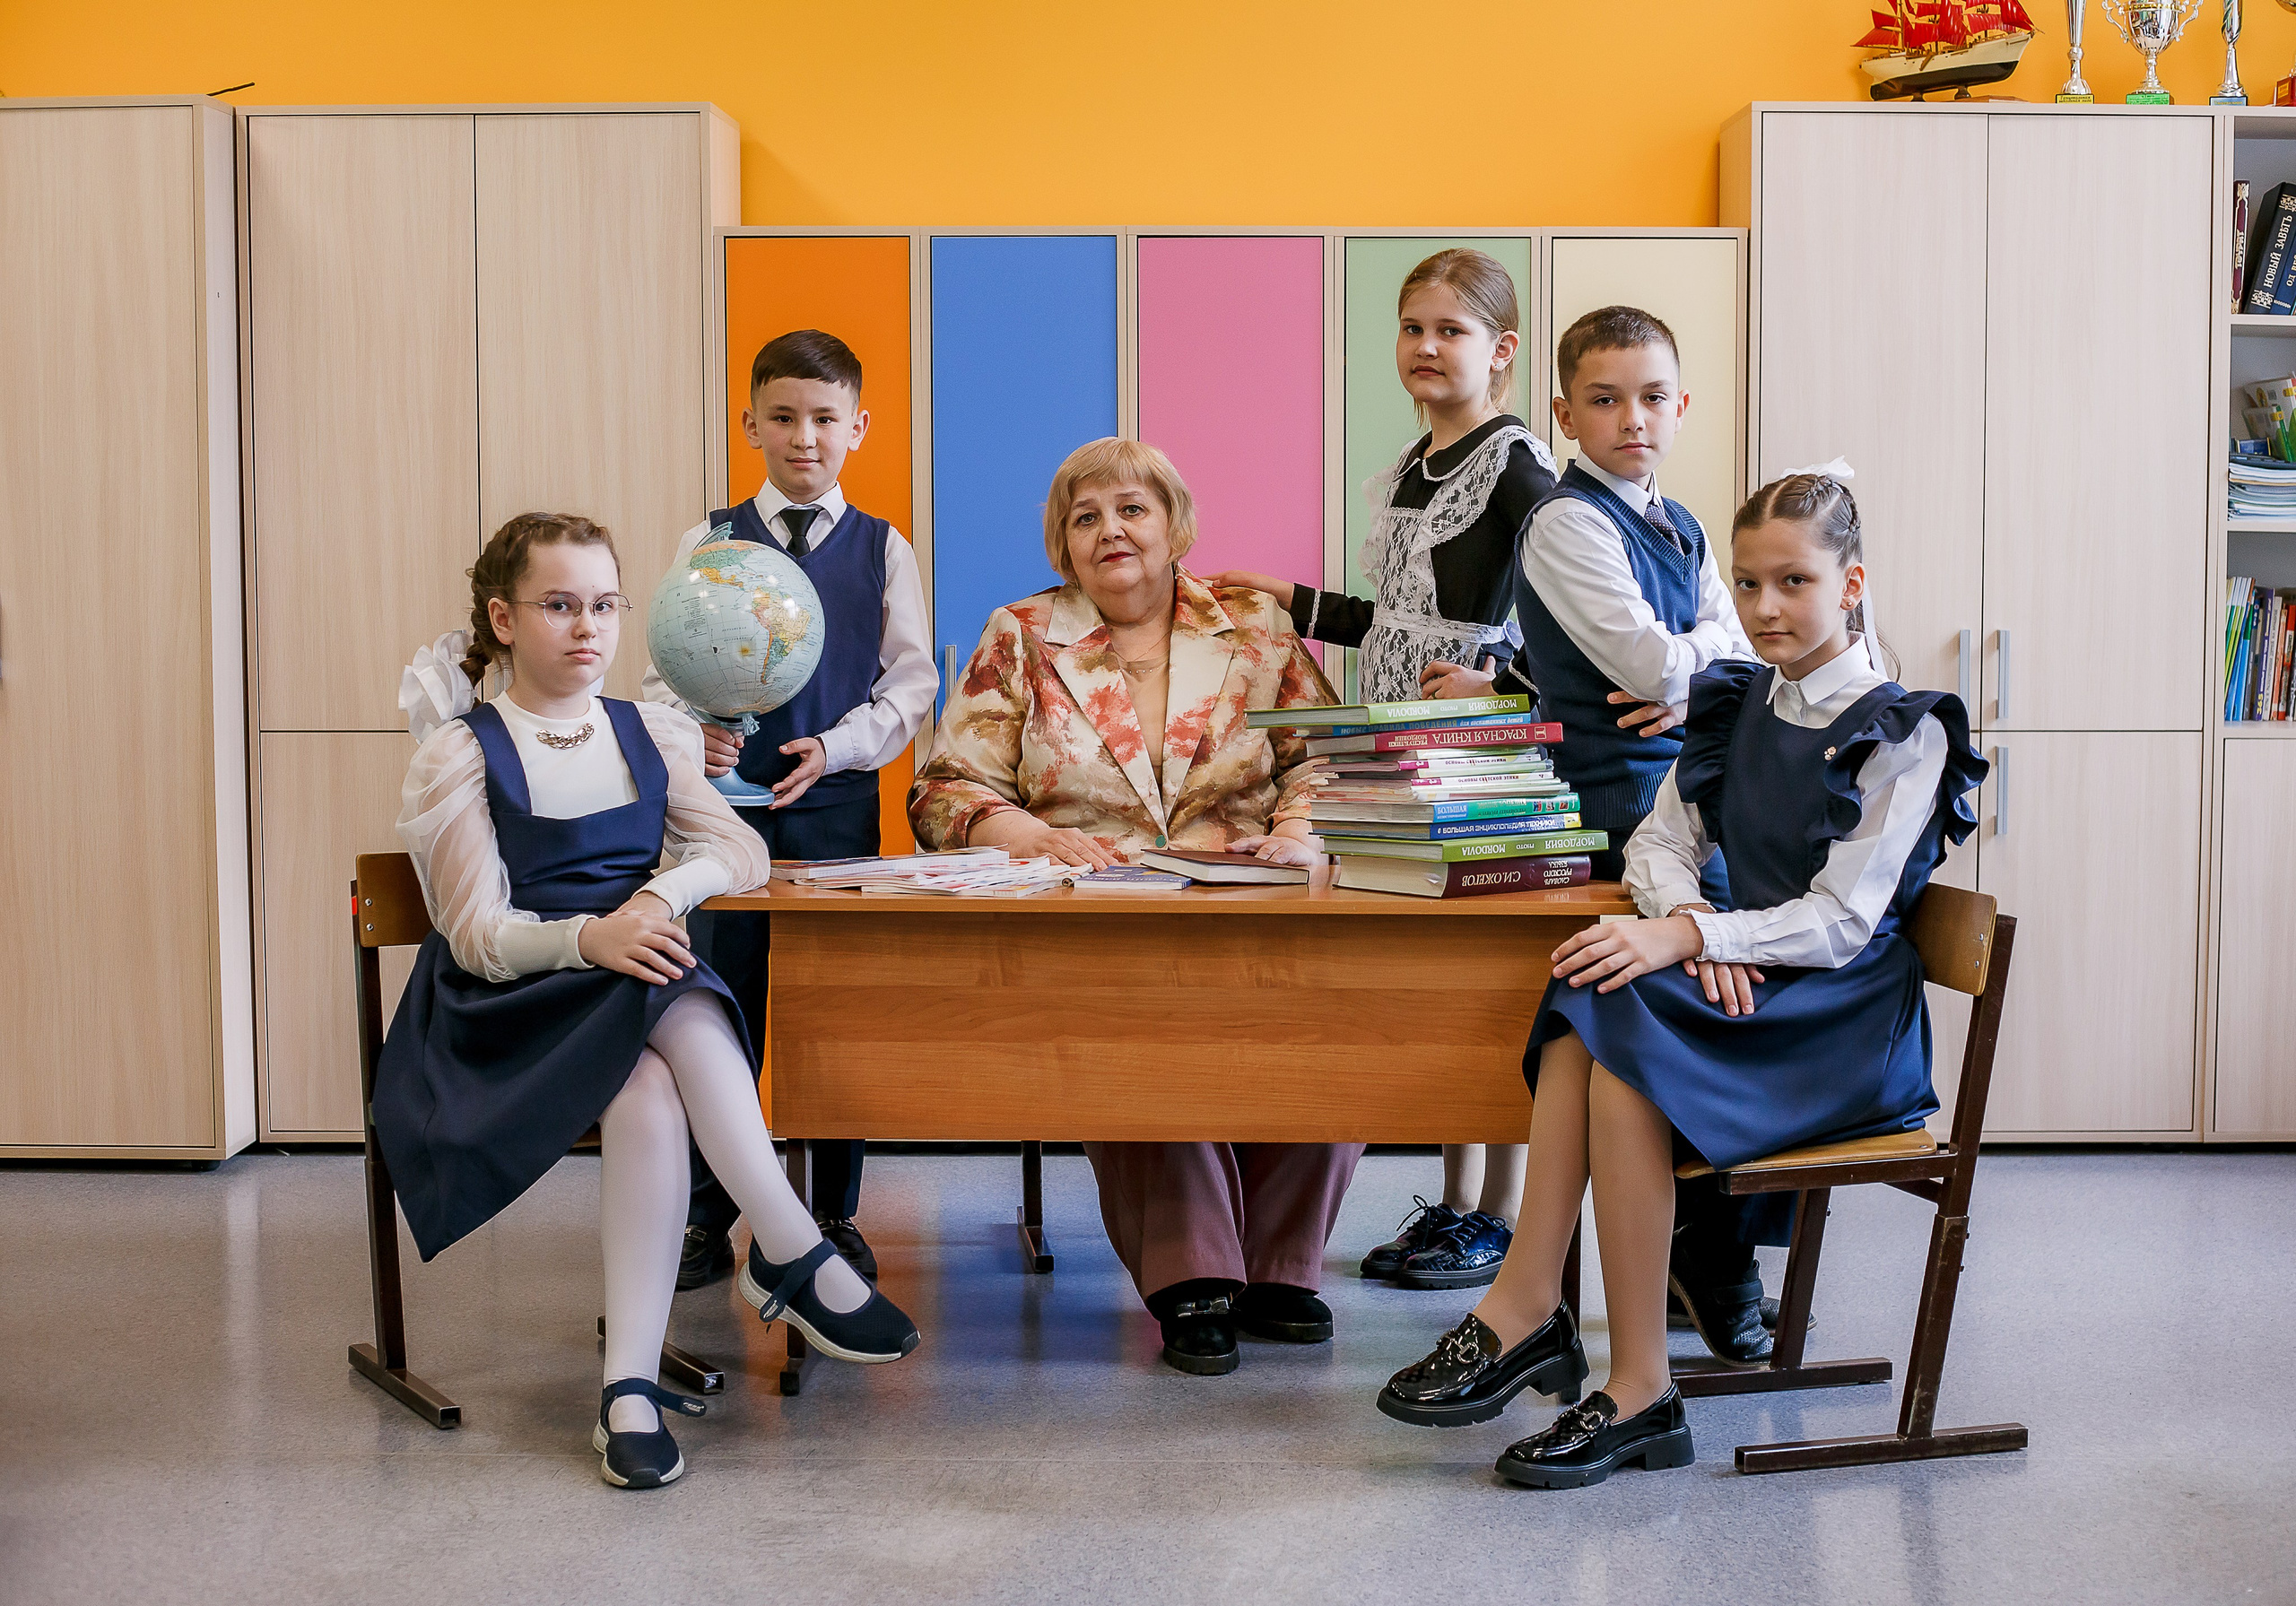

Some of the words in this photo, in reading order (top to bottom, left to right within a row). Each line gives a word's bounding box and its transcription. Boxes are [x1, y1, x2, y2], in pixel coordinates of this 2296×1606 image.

[2264, 252, 2282, 289] НОВЫЙ
[1440, 704, 1458, 712] PHOTO
[1468, 699, 1518, 712] МОРДОВИЯ
[1387, 706, 1431, 718] MORDOVIA
[1368, 723, 1405, 733] ПРАВИЛА
[1408, 720, 1457, 730] ПОВЕДЕНИЯ
[1432, 729, 1473, 744] КНИГА
[1474, 726, 1527, 742] КРАСНАЯ
[1437, 804, 1467, 815] БОЛЬШАЯ
[1442, 825, 1474, 834] БОЛЬШАЯ
[1475, 821, 1525, 832] ЭНЦИКЛОПЕДИЯ
[1526, 819, 1555, 829] ТЕХНИКИ
[1544, 837, 1596, 849] МОРДОВИЯ
[1462, 844, 1506, 856] MORDOVIA
[1544, 868, 1572, 878] РУССКОГО
[1544, 877, 1570, 886] СЛОВАРЬ
